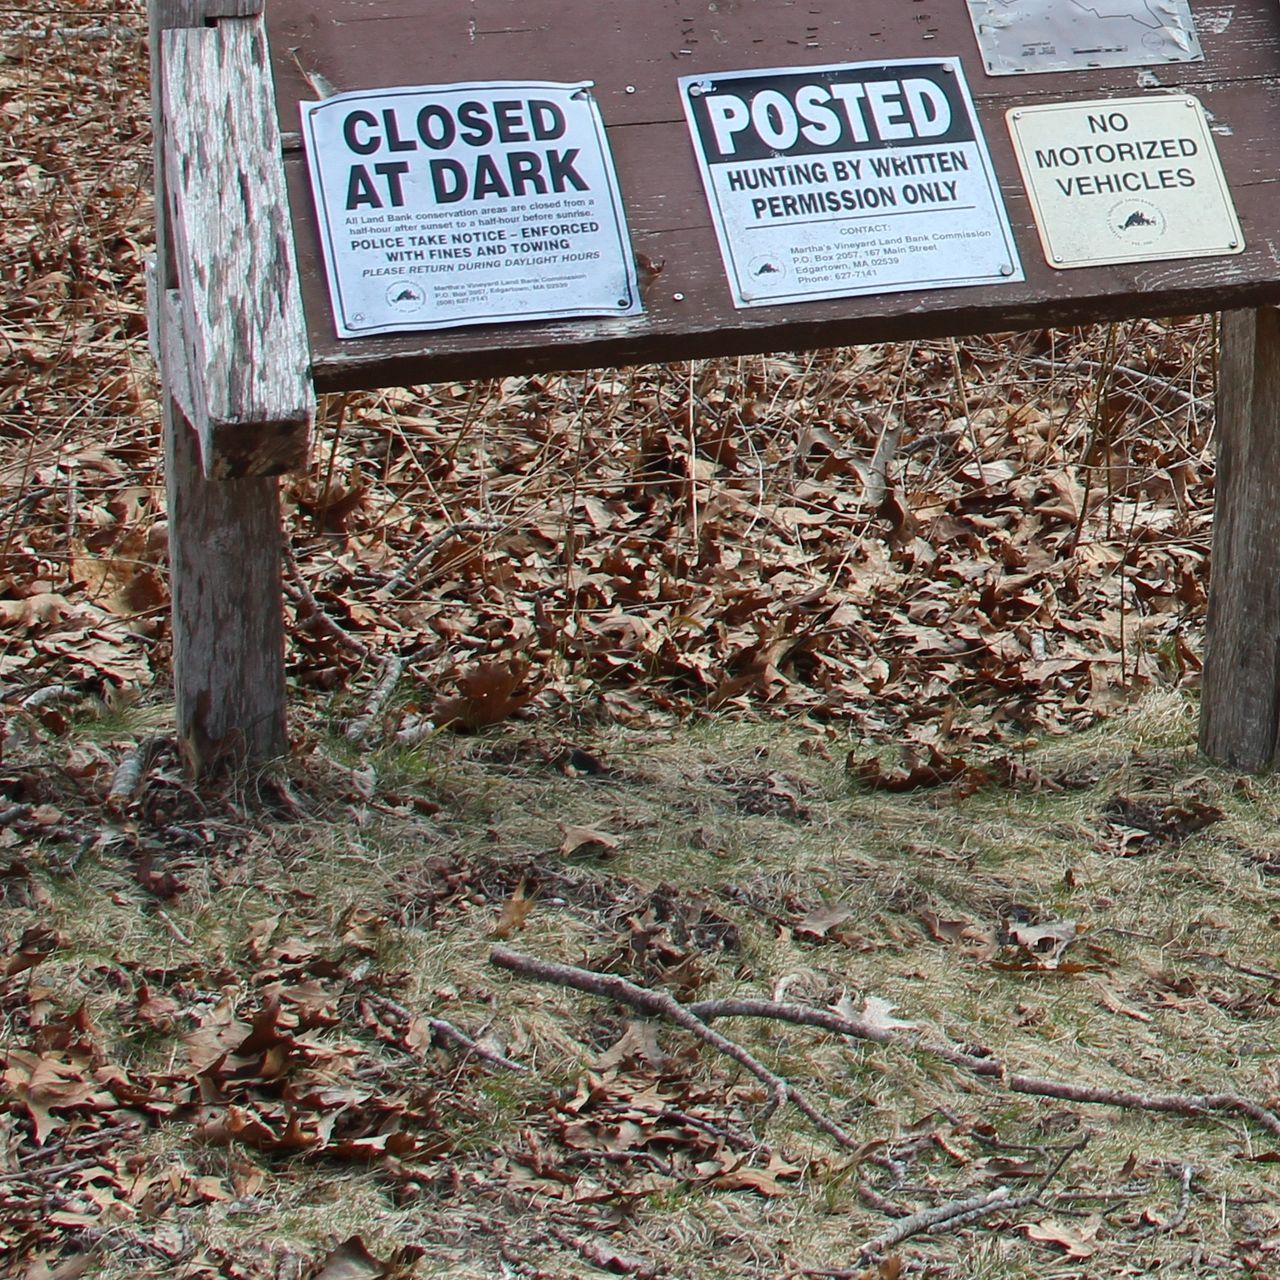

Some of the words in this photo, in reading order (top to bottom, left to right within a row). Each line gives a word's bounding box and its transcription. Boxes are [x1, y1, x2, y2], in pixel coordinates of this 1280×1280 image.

[343, 99, 568, 156] CLOSED
[705, 78, 952, 156] POSTED
[1087, 112, 1129, 134] NO
[1035, 138, 1199, 169] MOTORIZED
[345, 161, 410, 211] AT
[429, 147, 592, 205] DARK
[727, 162, 829, 192] HUNTING
[832, 159, 862, 182] BY
[869, 150, 970, 178] WRITTEN
[1056, 168, 1196, 197] VEHICLES
[345, 217, 358, 225] All
[361, 215, 385, 224] Land
[387, 213, 413, 222] Bank
[415, 209, 479, 221] conservation
[481, 205, 508, 215] areas
[511, 204, 527, 212] are
[529, 200, 561, 211] closed
[564, 198, 586, 208] from
[752, 185, 898, 220] PERMISSION
[901, 180, 958, 205] ONLY
[349, 225, 392, 235] half-hour
[395, 224, 418, 232] after
[420, 221, 454, 230] sunset
[456, 220, 467, 229] to
[478, 215, 521, 227] half-hour
[523, 212, 554, 222] before
[556, 209, 595, 220] sunrise.
[840, 224, 891, 235] CONTACT:
[351, 237, 405, 251] POLICE
[408, 234, 448, 247] TAKE
[451, 229, 507, 244] NOTICE
[521, 222, 600, 239] ENFORCED
[790, 244, 832, 254] Martha's
[834, 239, 876, 250] Vineyard
[879, 236, 903, 246] Land
[905, 234, 930, 243] Bank
[932, 229, 992, 241] Commission
[362, 266, 406, 278] PLEASE
[408, 263, 455, 275] RETURN
[457, 259, 501, 271] DURING
[504, 255, 559, 268] DAYLIGHT
[561, 250, 601, 263] HOURS
[386, 249, 425, 262] WITH
[428, 247, 472, 260] FINES
[476, 244, 507, 257] AND
[510, 239, 571, 254] TOWING
[793, 256, 812, 265] P.O.
[814, 254, 833, 262] Box
[883, 245, 907, 255] Main
[909, 243, 938, 253] Street
[795, 263, 851, 274] Edgartown,
[853, 259, 869, 268] MA
[871, 257, 900, 266] 02539
[797, 275, 833, 284] Phone:
[835, 269, 877, 280] 627-7141
[466, 280, 499, 288] Vineyard
